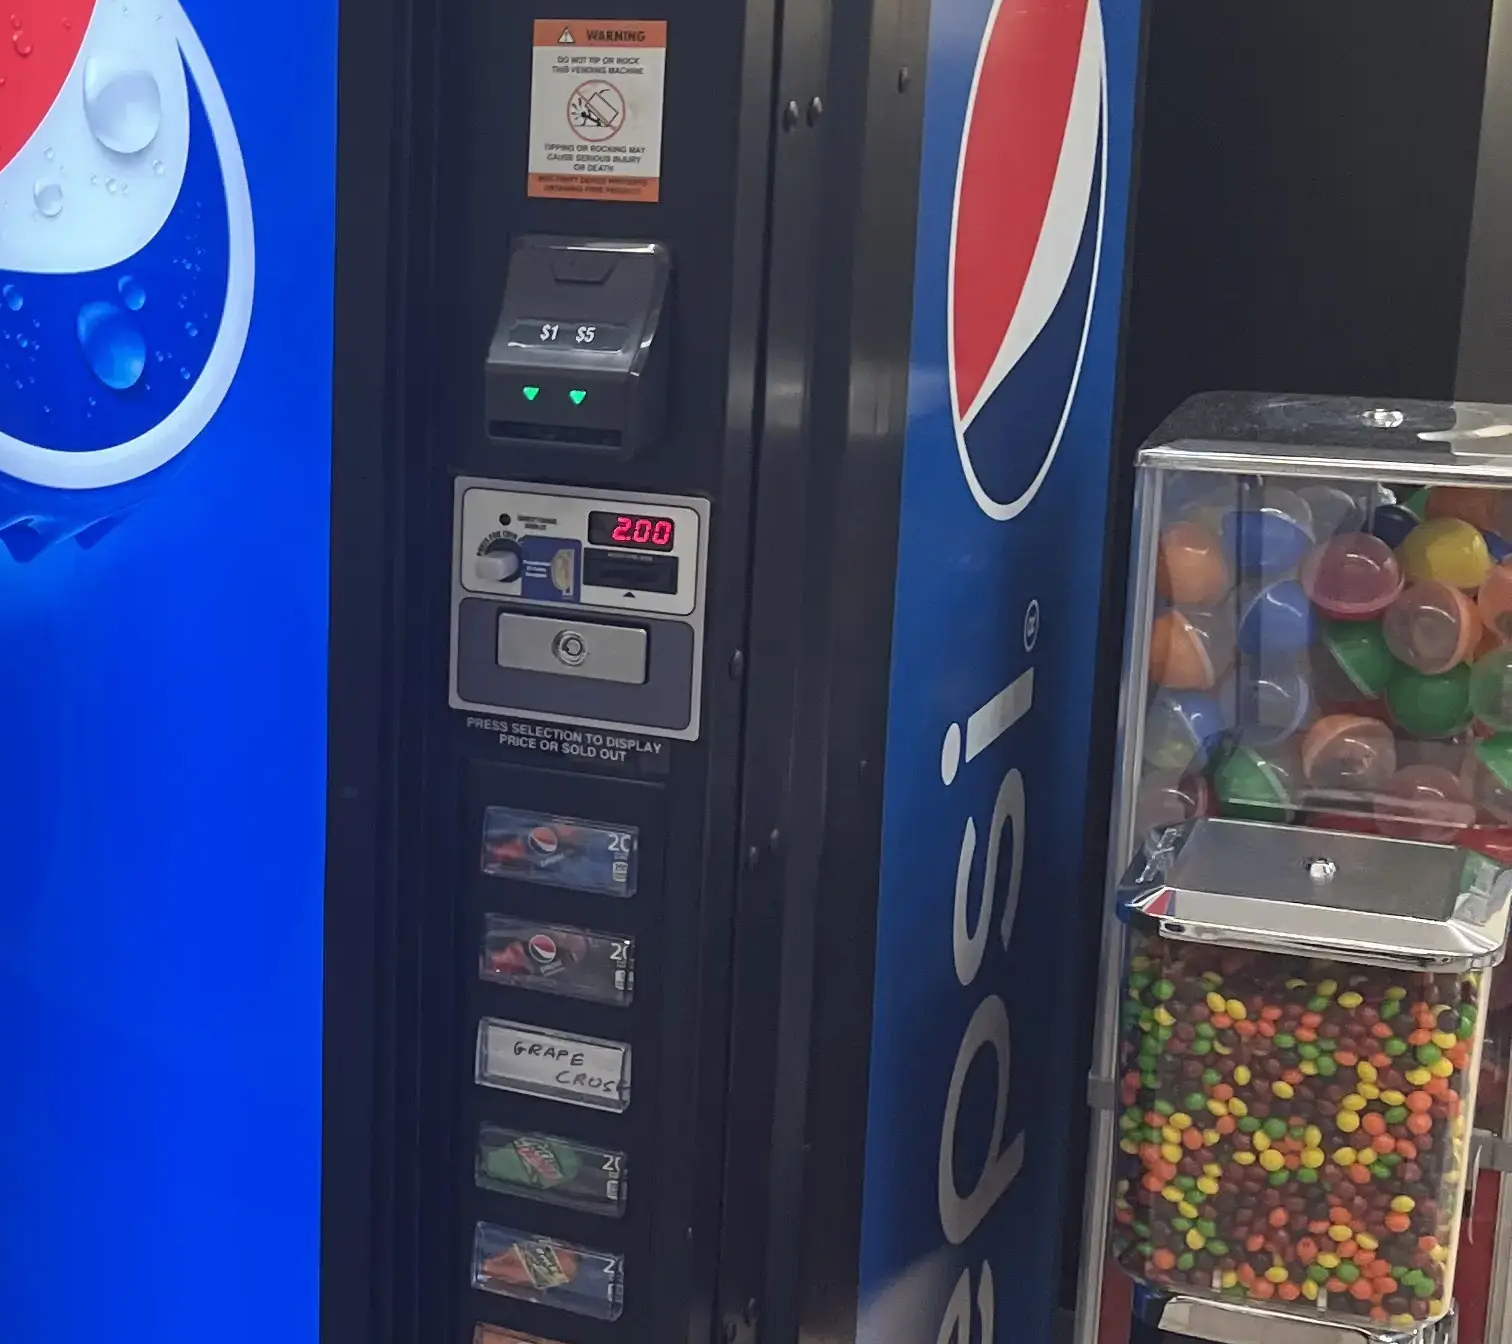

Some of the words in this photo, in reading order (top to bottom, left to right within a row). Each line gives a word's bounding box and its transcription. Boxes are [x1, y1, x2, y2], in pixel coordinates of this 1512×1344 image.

[586, 29, 646, 43] WARNING
[540, 324, 559, 341] $1
[575, 326, 596, 343] $5
[466, 716, 508, 732] PRESS
[511, 722, 582, 742] SELECTION
[585, 733, 603, 746] TO
[607, 736, 662, 754] DISPLAY
[499, 734, 537, 749] PRICE
[540, 740, 558, 752] OR
[562, 742, 596, 758] SOLD
[600, 749, 627, 762] OUT
[513, 1041, 585, 1066] GRAPE
